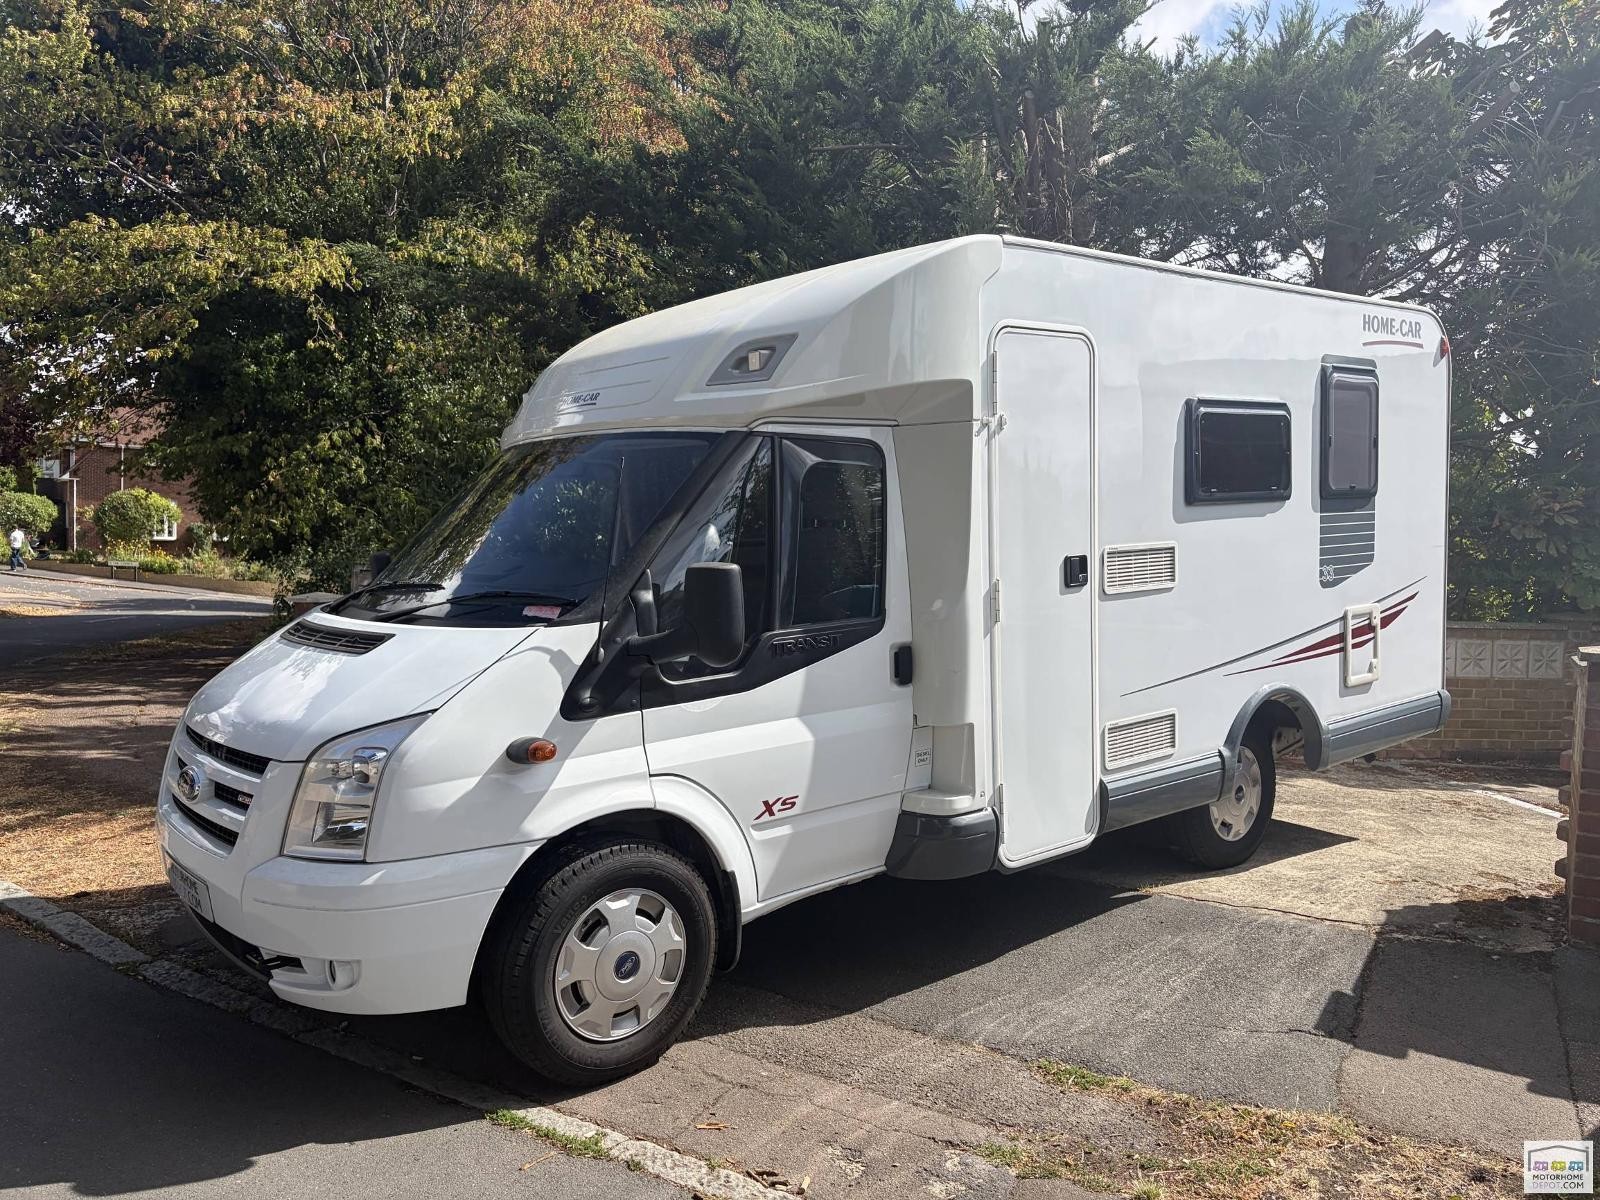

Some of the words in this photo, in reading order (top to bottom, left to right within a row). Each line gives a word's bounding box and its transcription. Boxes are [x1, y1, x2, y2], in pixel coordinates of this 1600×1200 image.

[1362, 314, 1422, 339] HOME-CAR
[772, 633, 844, 655] TRANSIT
[753, 795, 799, 821] XS
